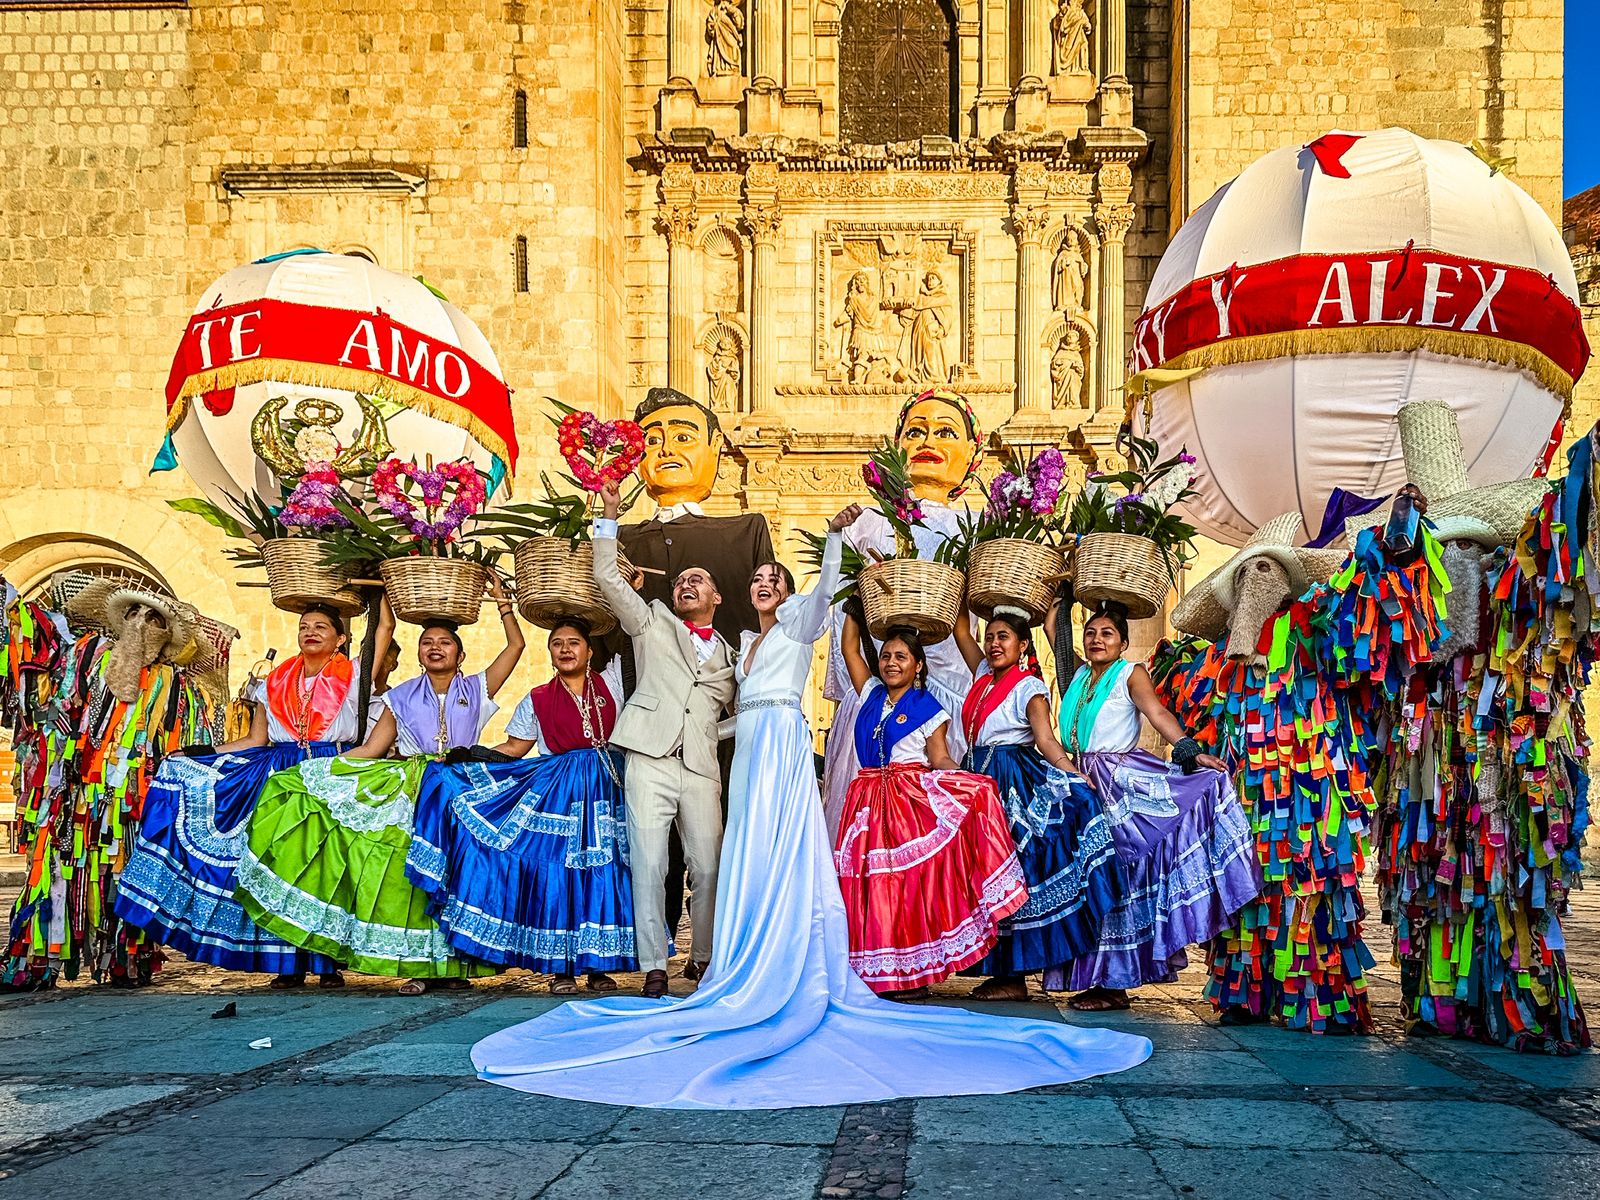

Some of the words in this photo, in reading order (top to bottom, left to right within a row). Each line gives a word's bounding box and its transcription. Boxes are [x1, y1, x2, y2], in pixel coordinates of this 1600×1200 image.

[1210, 273, 1248, 338] Y
[1307, 259, 1507, 332] ALEX
[193, 311, 262, 369] TE
[338, 319, 471, 398] AMO
